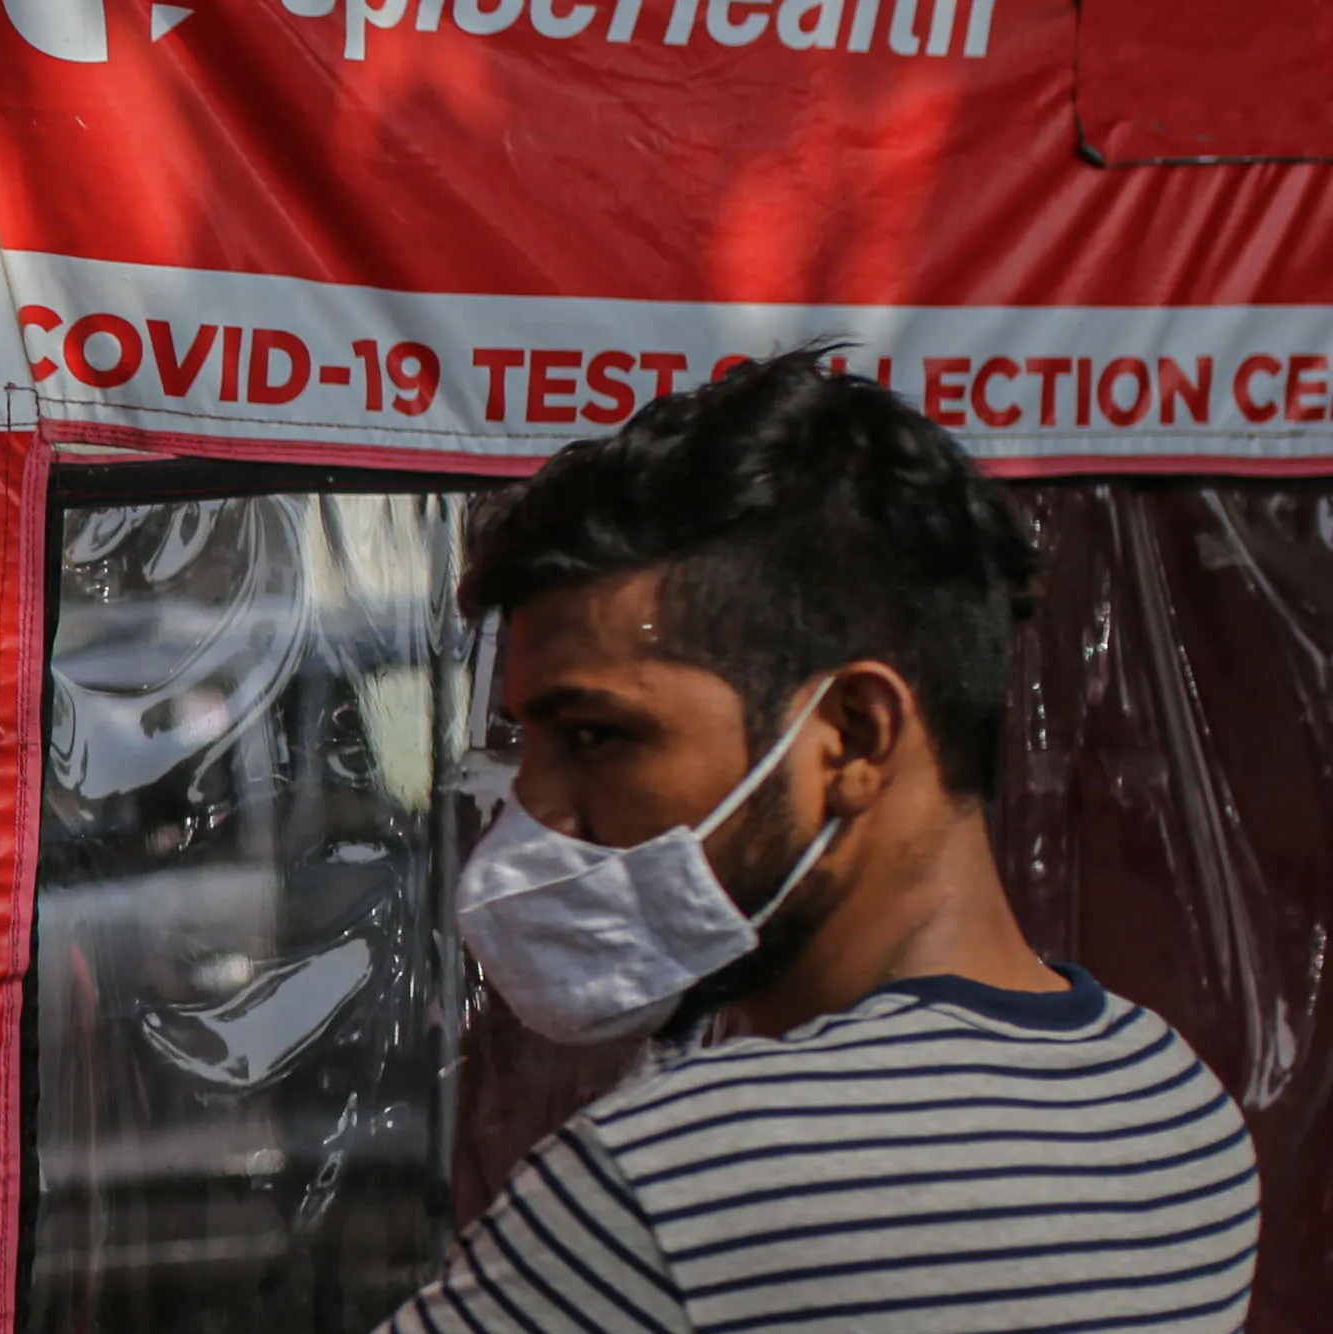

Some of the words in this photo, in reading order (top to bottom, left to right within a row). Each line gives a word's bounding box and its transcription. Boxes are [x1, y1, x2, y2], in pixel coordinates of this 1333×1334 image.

[17, 305, 440, 417] COVID-19
[473, 347, 687, 425] TEST
[711, 354, 1213, 427] ECTION
[1233, 354, 1333, 424] CE
